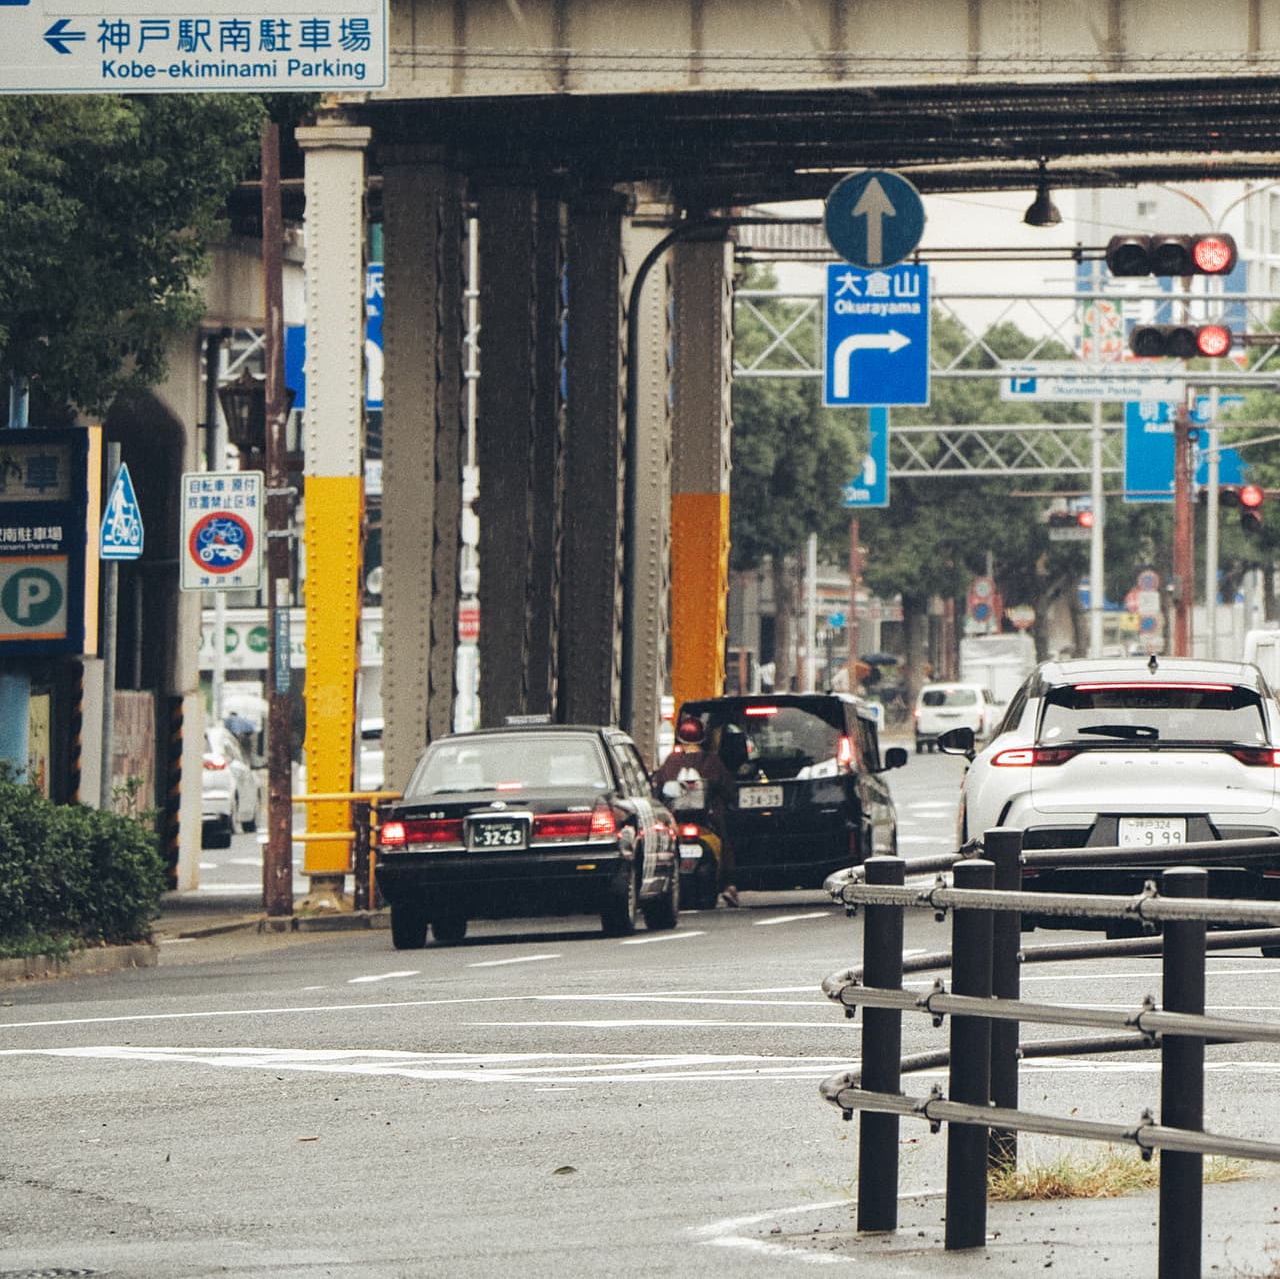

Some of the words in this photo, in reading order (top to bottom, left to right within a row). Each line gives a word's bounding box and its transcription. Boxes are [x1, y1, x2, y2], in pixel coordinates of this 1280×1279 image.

[97, 18, 372, 54] 神戸駅南駐車場
[102, 60, 277, 78] Kobe-ekiminami
[287, 59, 366, 80] Parking
[835, 271, 919, 297] 大倉山
[834, 299, 921, 316] Okurayama
[17, 577, 50, 619] P
[483, 830, 521, 845] 32-63
